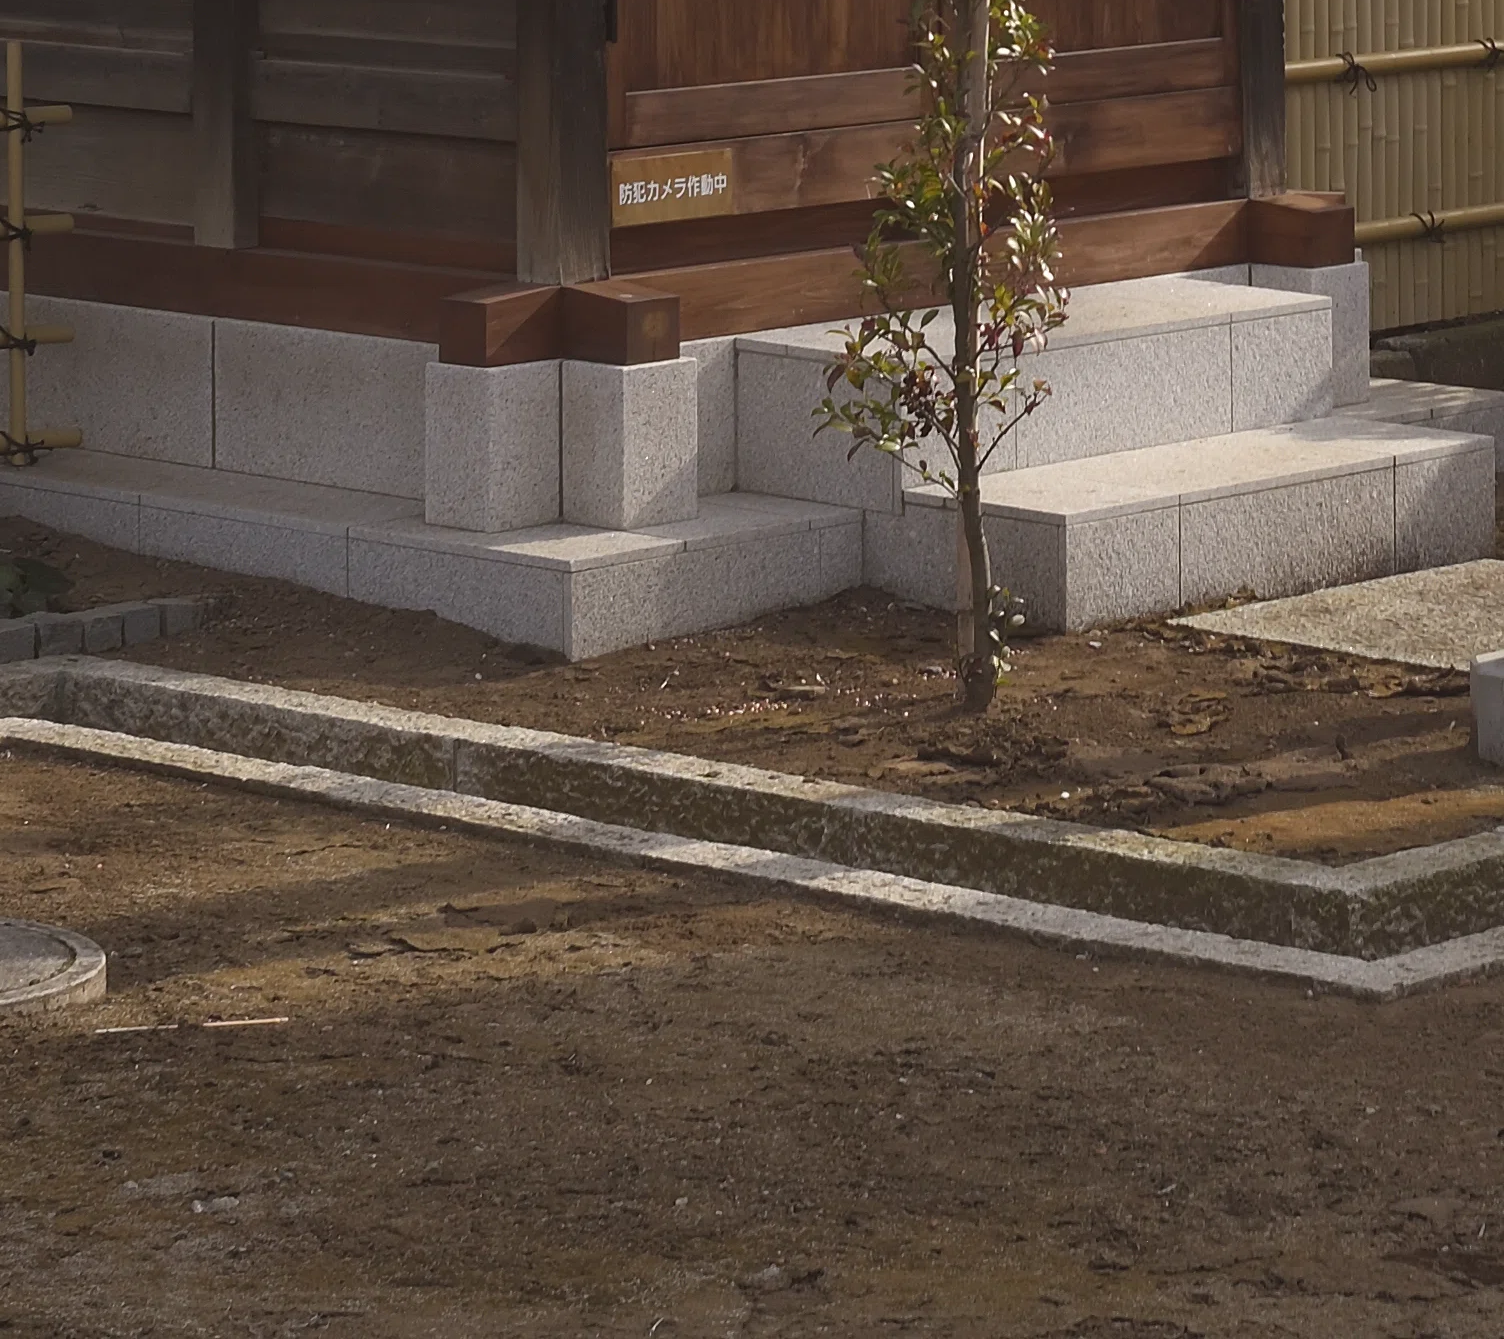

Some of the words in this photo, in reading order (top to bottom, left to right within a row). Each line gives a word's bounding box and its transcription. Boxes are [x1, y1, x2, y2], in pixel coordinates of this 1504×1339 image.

[619, 172, 727, 206] 防犯カメラ作動中
